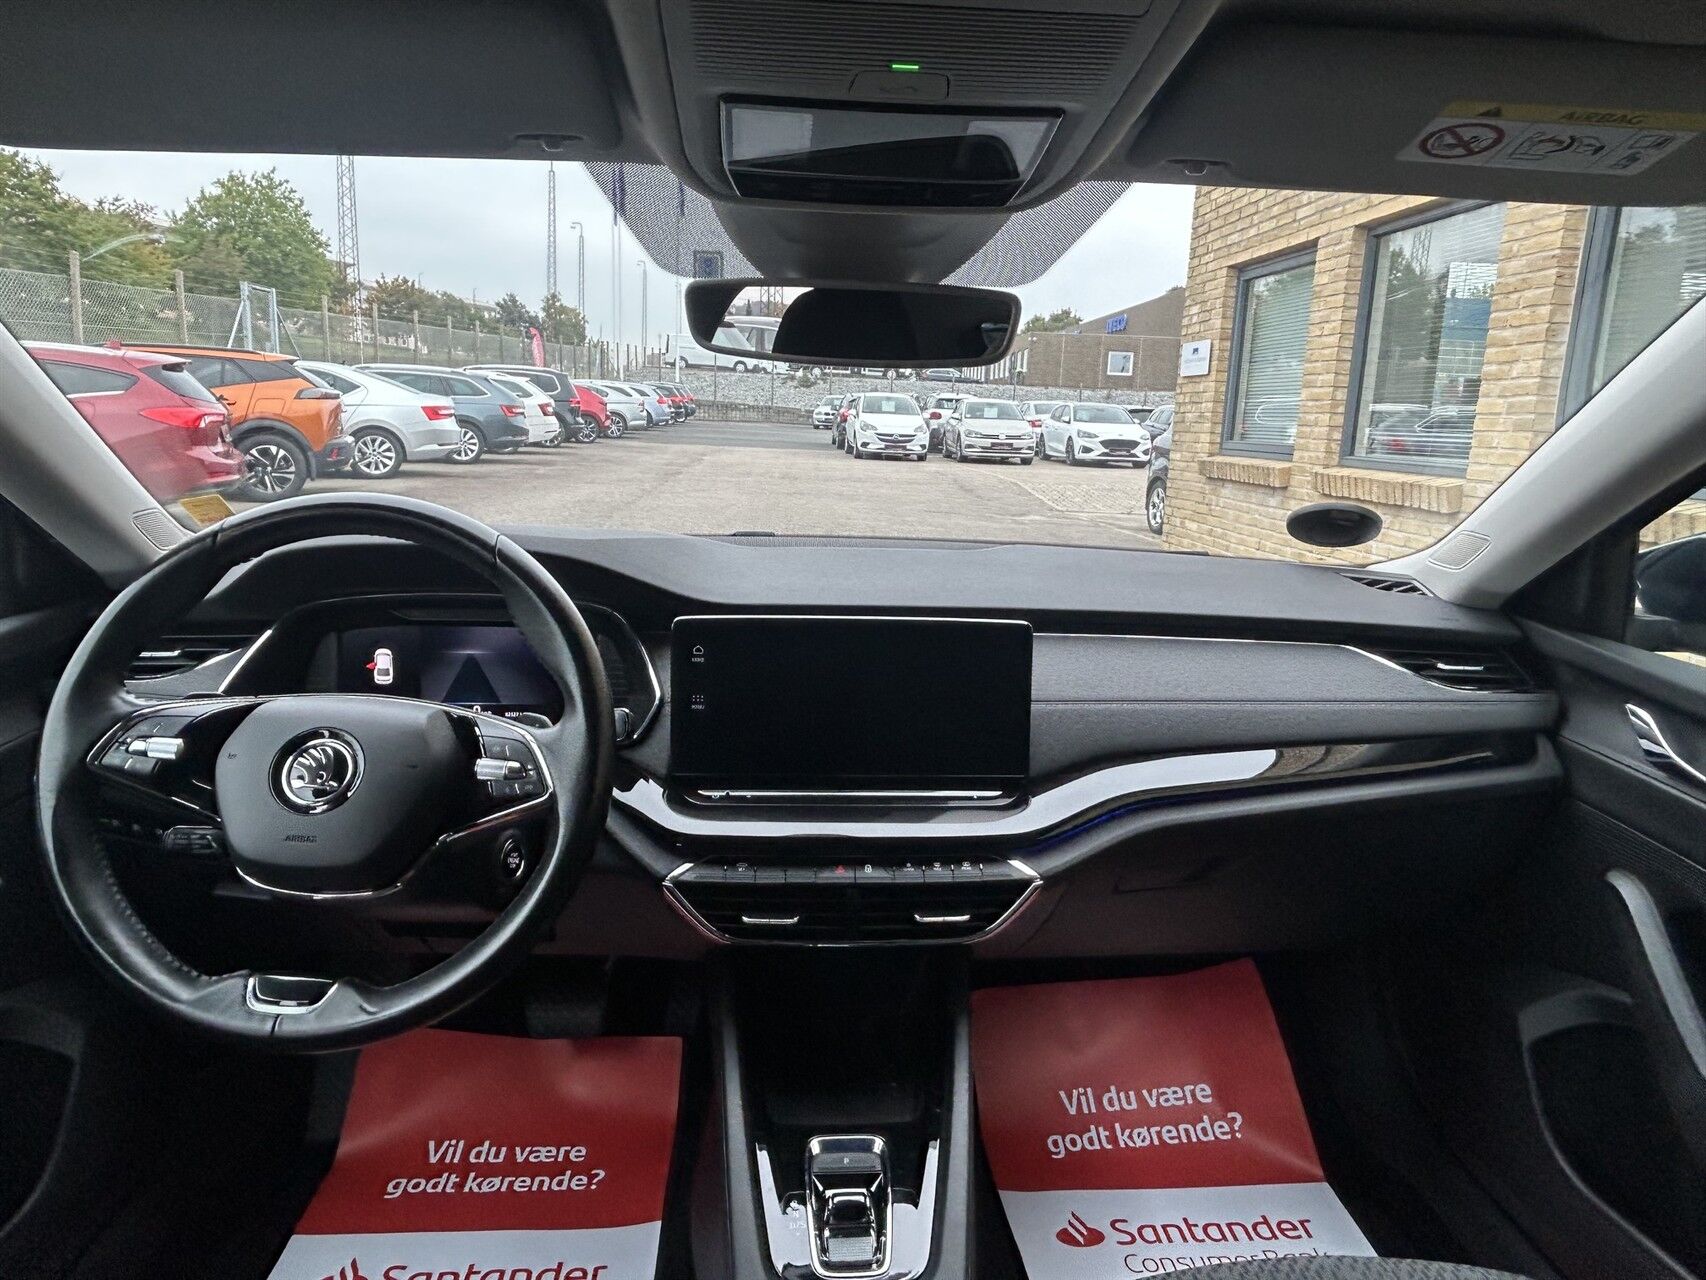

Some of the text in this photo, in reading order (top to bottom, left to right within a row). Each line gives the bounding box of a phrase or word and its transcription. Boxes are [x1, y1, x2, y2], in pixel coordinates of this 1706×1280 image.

[1559, 109, 1649, 126] AIRBAG
[1058, 1082, 1212, 1115] Vil du være
[1047, 1112, 1243, 1159] godt kørende?
[427, 1139, 586, 1163] Vil du være
[384, 1169, 606, 1199] godt kørende?
[1110, 1215, 1314, 1246] Santander
